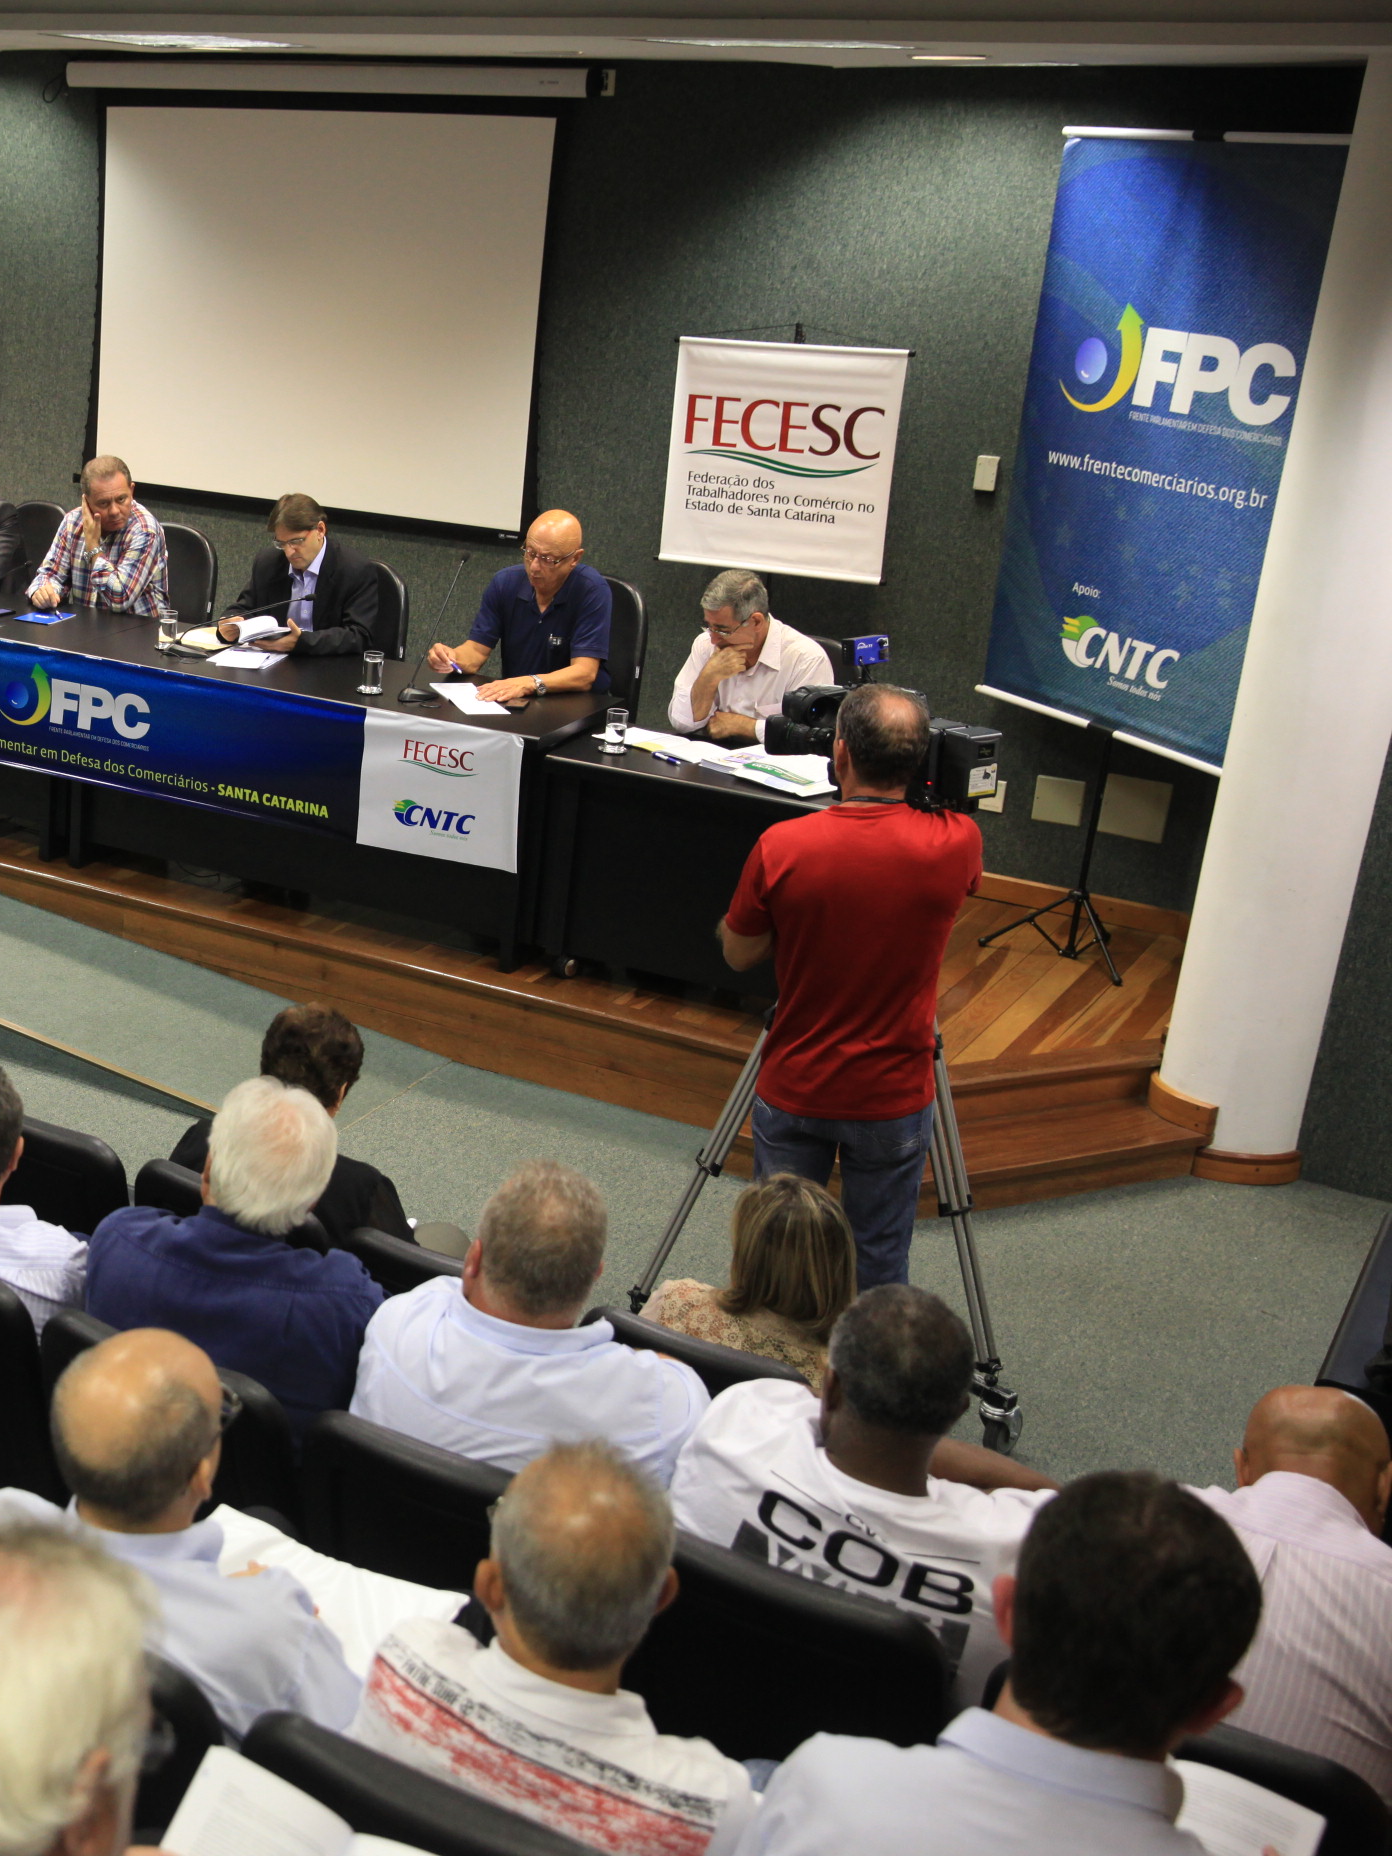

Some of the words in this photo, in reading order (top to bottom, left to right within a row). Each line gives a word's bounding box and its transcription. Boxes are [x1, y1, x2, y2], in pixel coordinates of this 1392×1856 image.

[1131, 327, 1296, 426] FPC
[684, 394, 886, 460] FECESC
[686, 485, 769, 504] Trabalhadores
[773, 495, 790, 505] no
[794, 495, 853, 512] Comércio
[858, 503, 875, 514] no
[687, 470, 749, 489] Federação
[752, 475, 775, 490] dos
[1048, 450, 1269, 510] www.frentecomerciarios.org.br
[685, 499, 723, 513] Estado
[727, 502, 743, 515] de
[747, 506, 781, 520] Santa
[784, 508, 836, 524] Catarina
[1072, 582, 1101, 599] Apoio:
[1075, 626, 1181, 689] CNTC
[50, 678, 150, 740] FPC
[403, 739, 474, 771] FECESC
[40, 747, 58, 760] em
[61, 749, 101, 769] Defesa
[104, 759, 125, 775] dos
[127, 764, 209, 793] Comerciários
[217, 783, 260, 805] SANTA
[262, 793, 329, 819] CATARINA
[404, 805, 476, 835] CNTC
